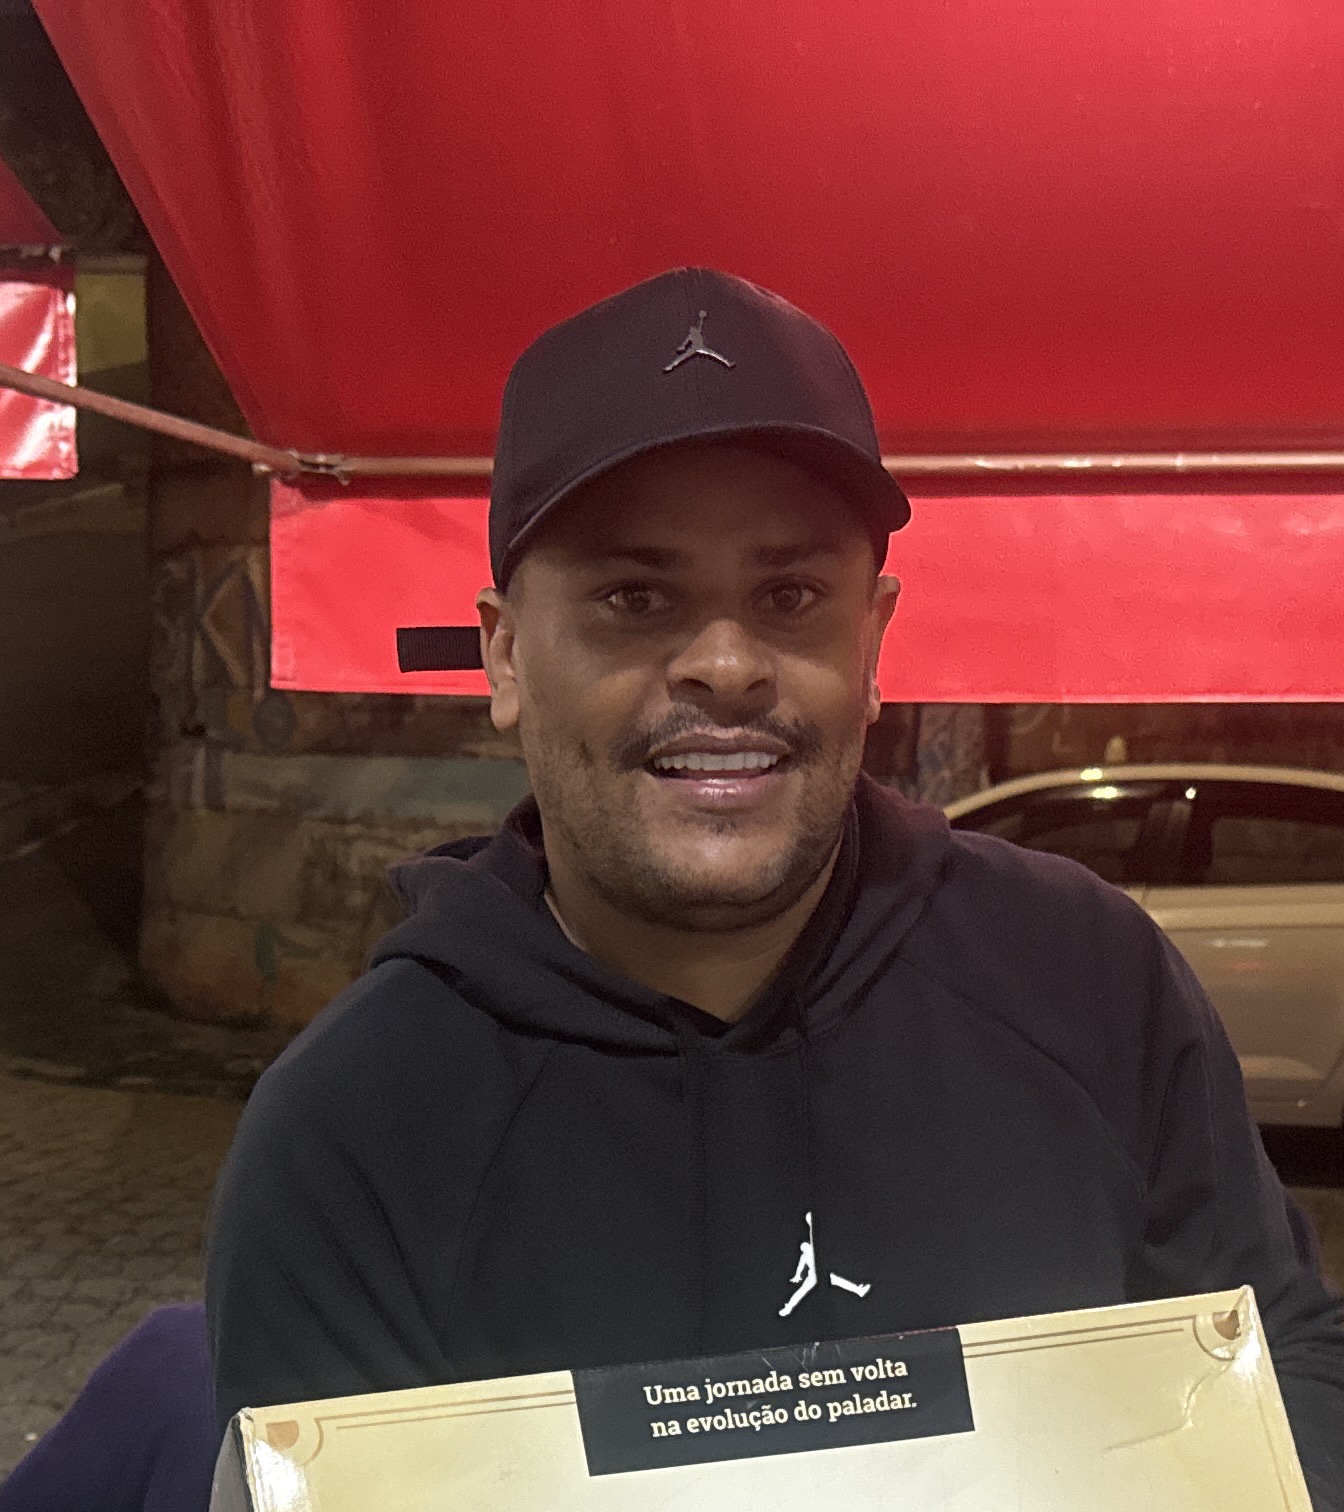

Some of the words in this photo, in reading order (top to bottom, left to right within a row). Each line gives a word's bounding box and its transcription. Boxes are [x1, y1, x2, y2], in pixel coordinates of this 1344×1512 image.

[643, 1384, 700, 1405] Uma
[704, 1371, 793, 1404] jornada
[798, 1366, 847, 1388] sem
[850, 1358, 909, 1381] volta
[650, 1419, 682, 1437] na
[687, 1404, 788, 1431] evolução
[794, 1400, 822, 1421] do
[826, 1390, 918, 1422] paladar.
